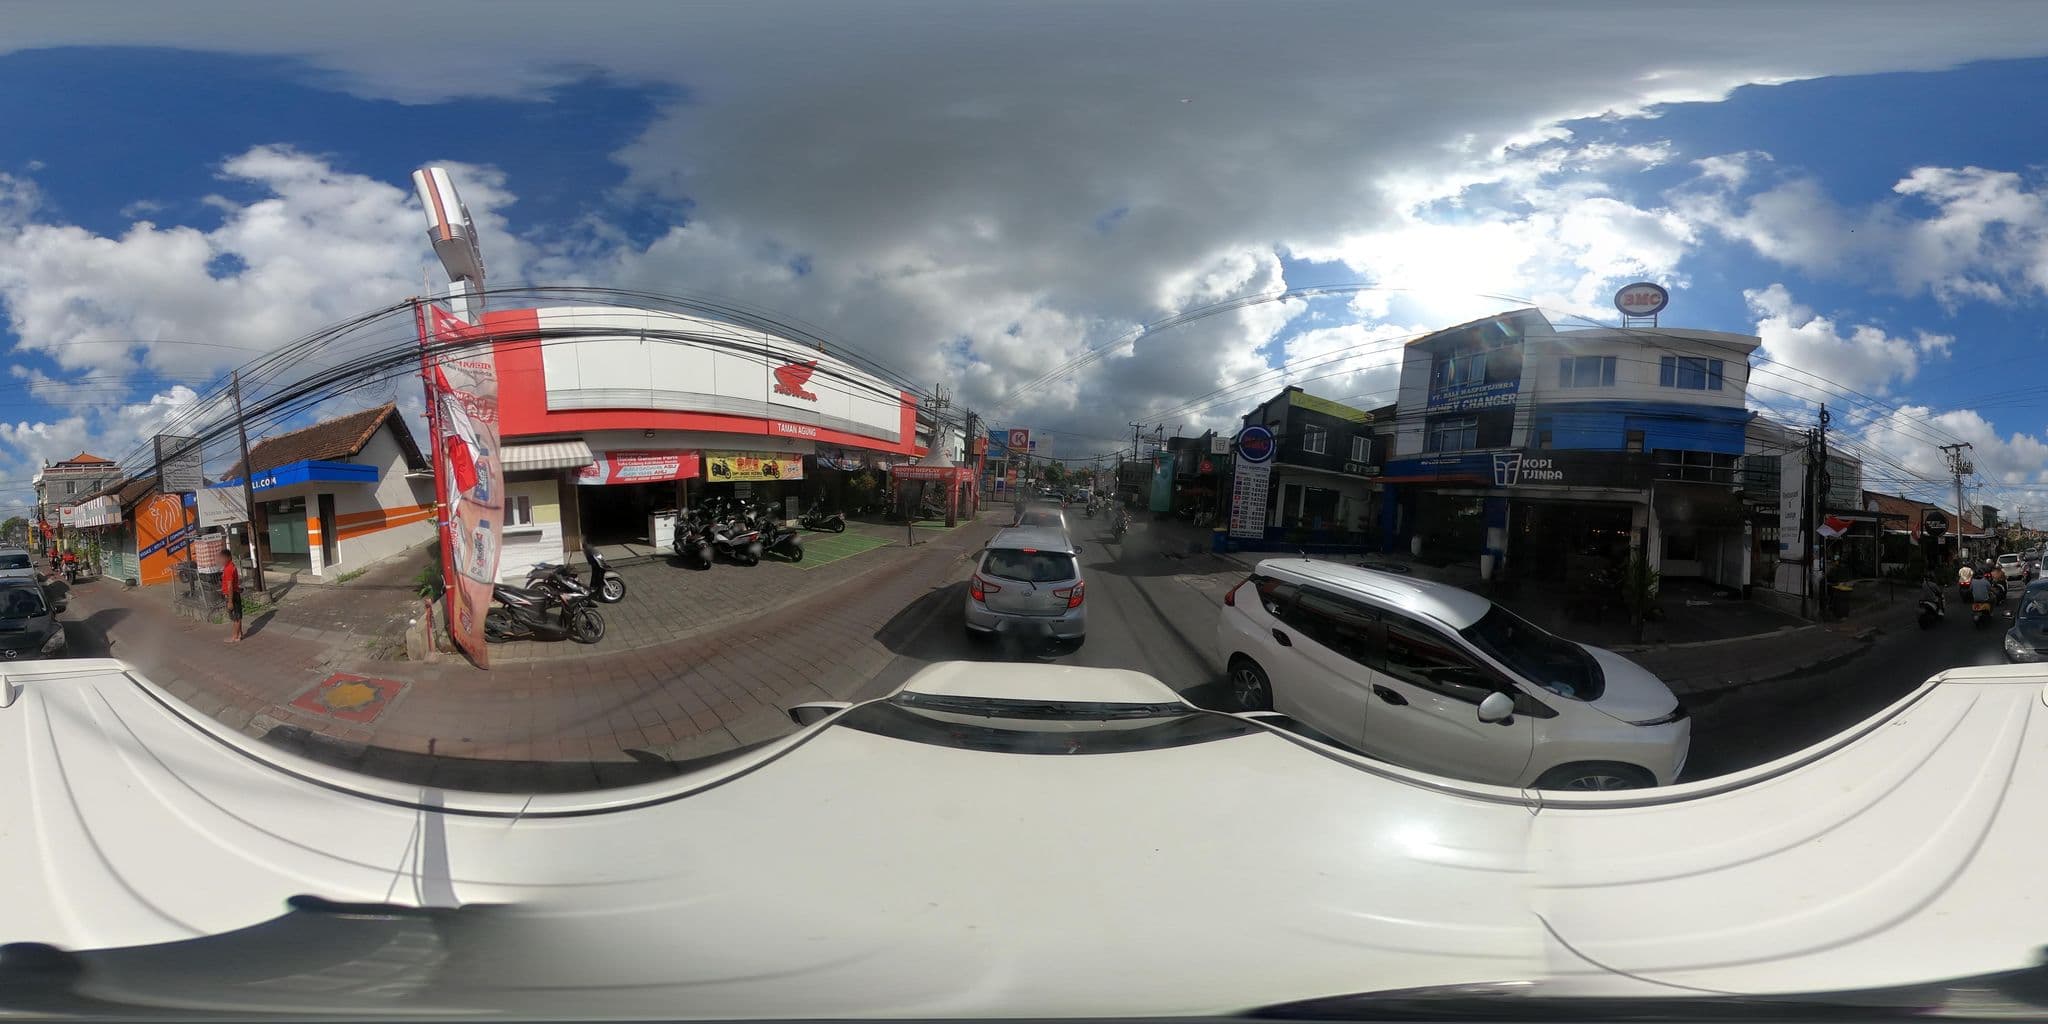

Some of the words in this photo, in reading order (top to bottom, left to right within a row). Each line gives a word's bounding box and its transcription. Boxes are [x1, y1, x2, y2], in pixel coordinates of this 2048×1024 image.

[1624, 293, 1661, 306] BMC
[1462, 393, 1517, 410] CHANGER
[777, 423, 798, 434] TAMAN
[798, 426, 817, 437] AGUNG
[1522, 459, 1552, 469] KOPI
[1522, 470, 1563, 480] TJINRA
